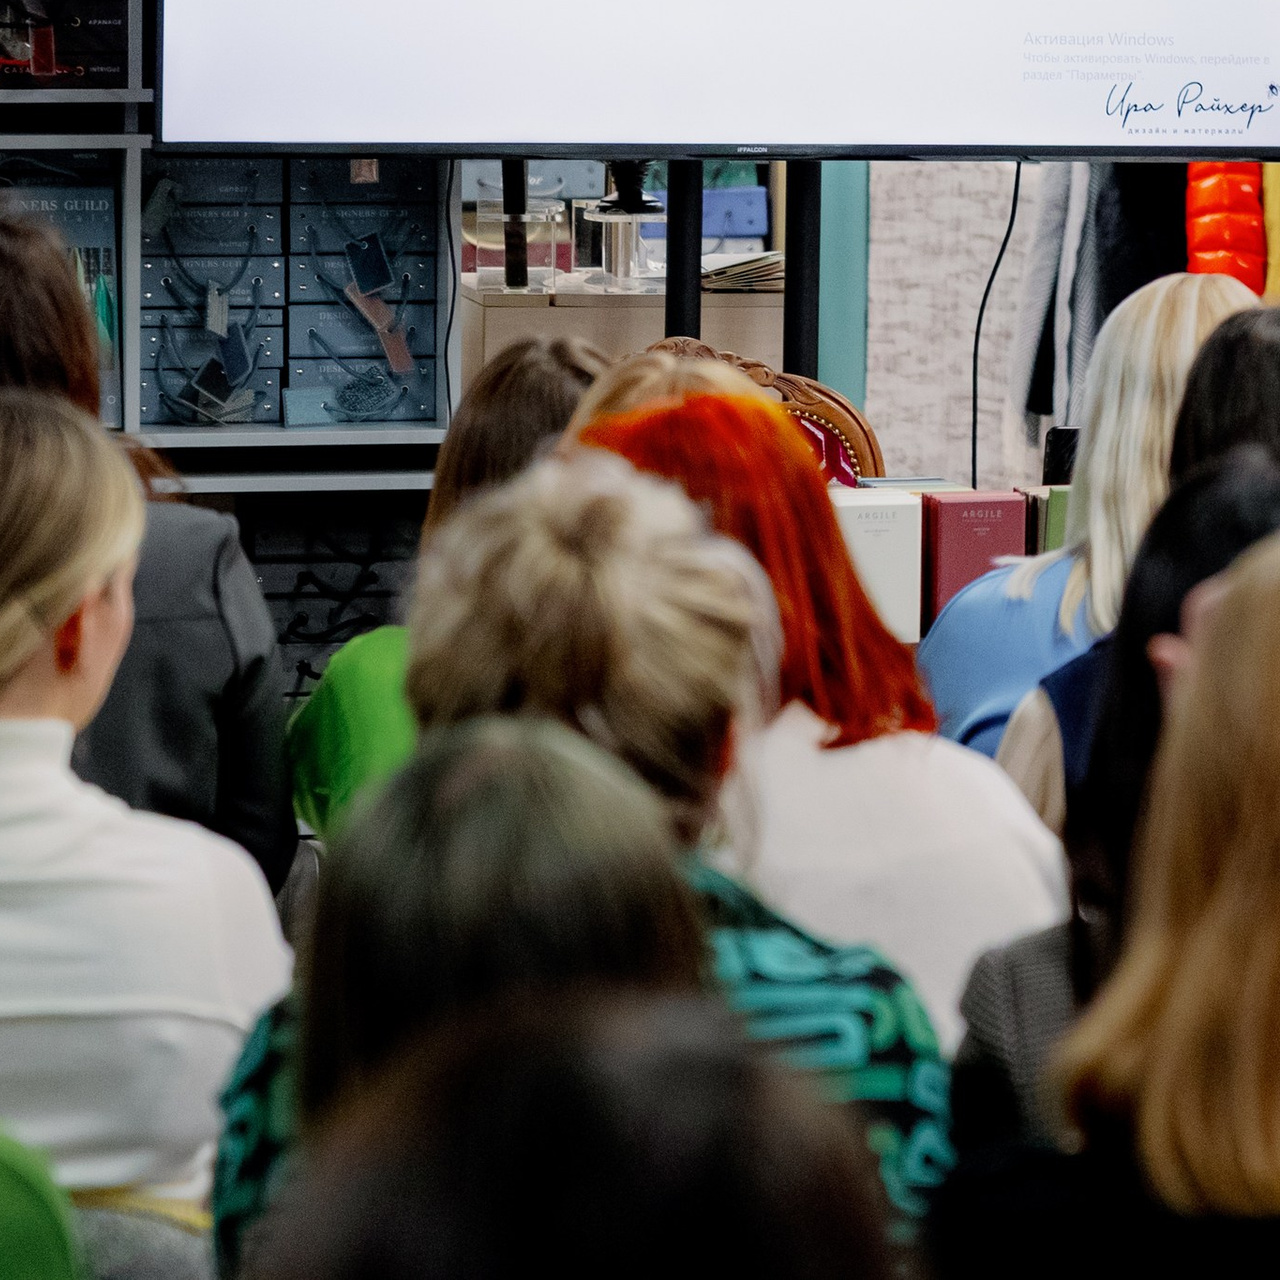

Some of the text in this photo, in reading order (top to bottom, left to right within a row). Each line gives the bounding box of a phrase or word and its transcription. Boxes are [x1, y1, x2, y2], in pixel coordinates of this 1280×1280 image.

[1023, 32, 1175, 48] Активация Windows
[1023, 52, 1060, 65] Чтобы
[1063, 54, 1142, 67] активировать
[1200, 54, 1261, 68] перейдите
[1263, 57, 1270, 66] в
[1023, 71, 1063, 83] раздел
[1105, 81, 1274, 129] Ира Райхер
[1128, 126, 1168, 136] дизайн
[1183, 127, 1244, 136] материалы
[64, 199, 110, 211] GUILD
[962, 509, 1003, 519] ARGILE
